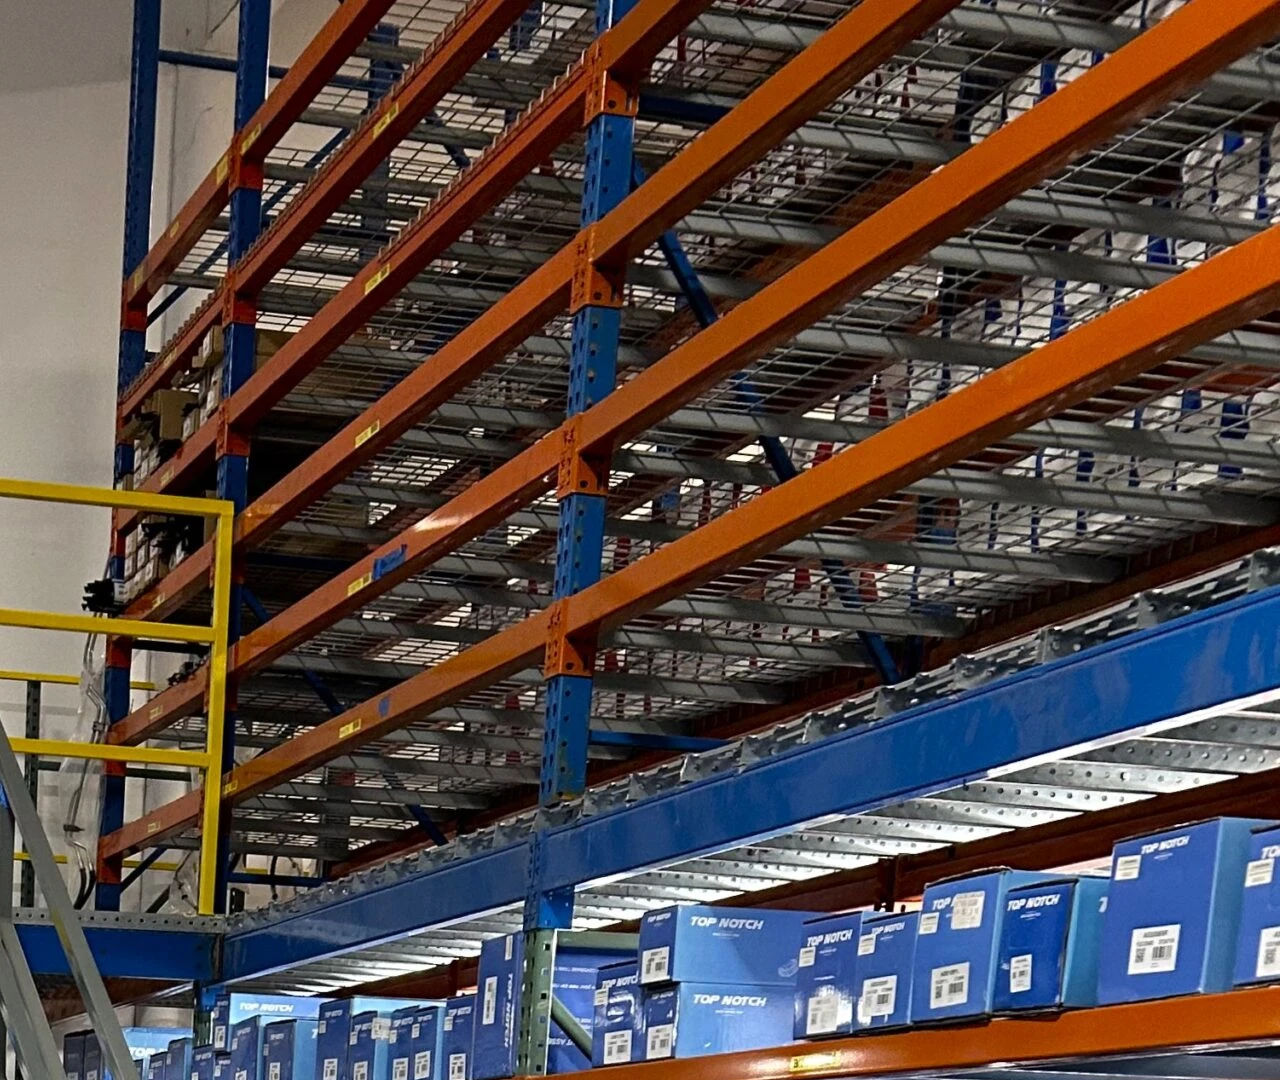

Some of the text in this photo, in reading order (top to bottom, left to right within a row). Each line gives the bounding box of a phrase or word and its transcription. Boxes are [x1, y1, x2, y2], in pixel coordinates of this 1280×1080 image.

[1141, 836, 1190, 854] TOP NOTCH
[1007, 894, 1061, 911] TOP NOTCH
[691, 916, 763, 930] TOP NOTCH
[871, 922, 904, 935] TOP NOTCH
[807, 930, 852, 946] TOP NOTCH
[694, 994, 766, 1007] TOP NOTCH
